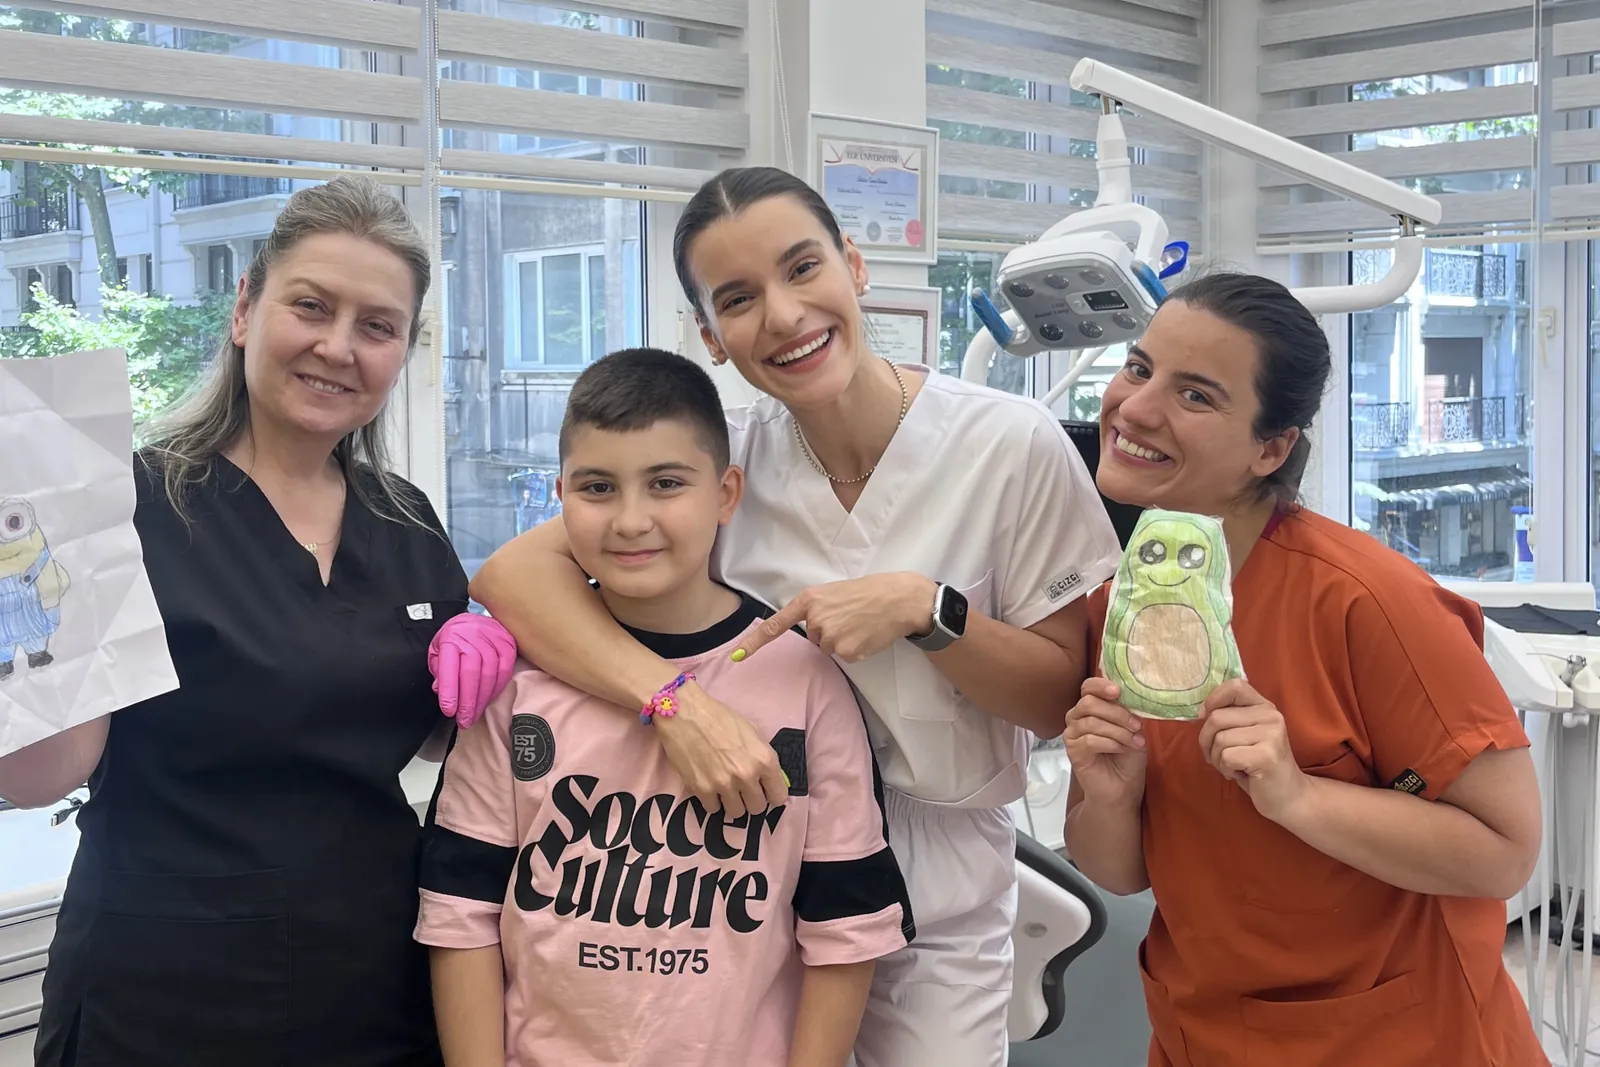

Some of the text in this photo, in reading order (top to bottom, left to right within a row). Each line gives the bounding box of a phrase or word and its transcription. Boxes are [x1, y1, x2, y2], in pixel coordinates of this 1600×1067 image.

[514, 734, 537, 746] EST
[514, 746, 537, 763] 75
[540, 774, 786, 861] Soccer
[514, 838, 769, 933] Culture
[578, 942, 710, 976] EST.1975
